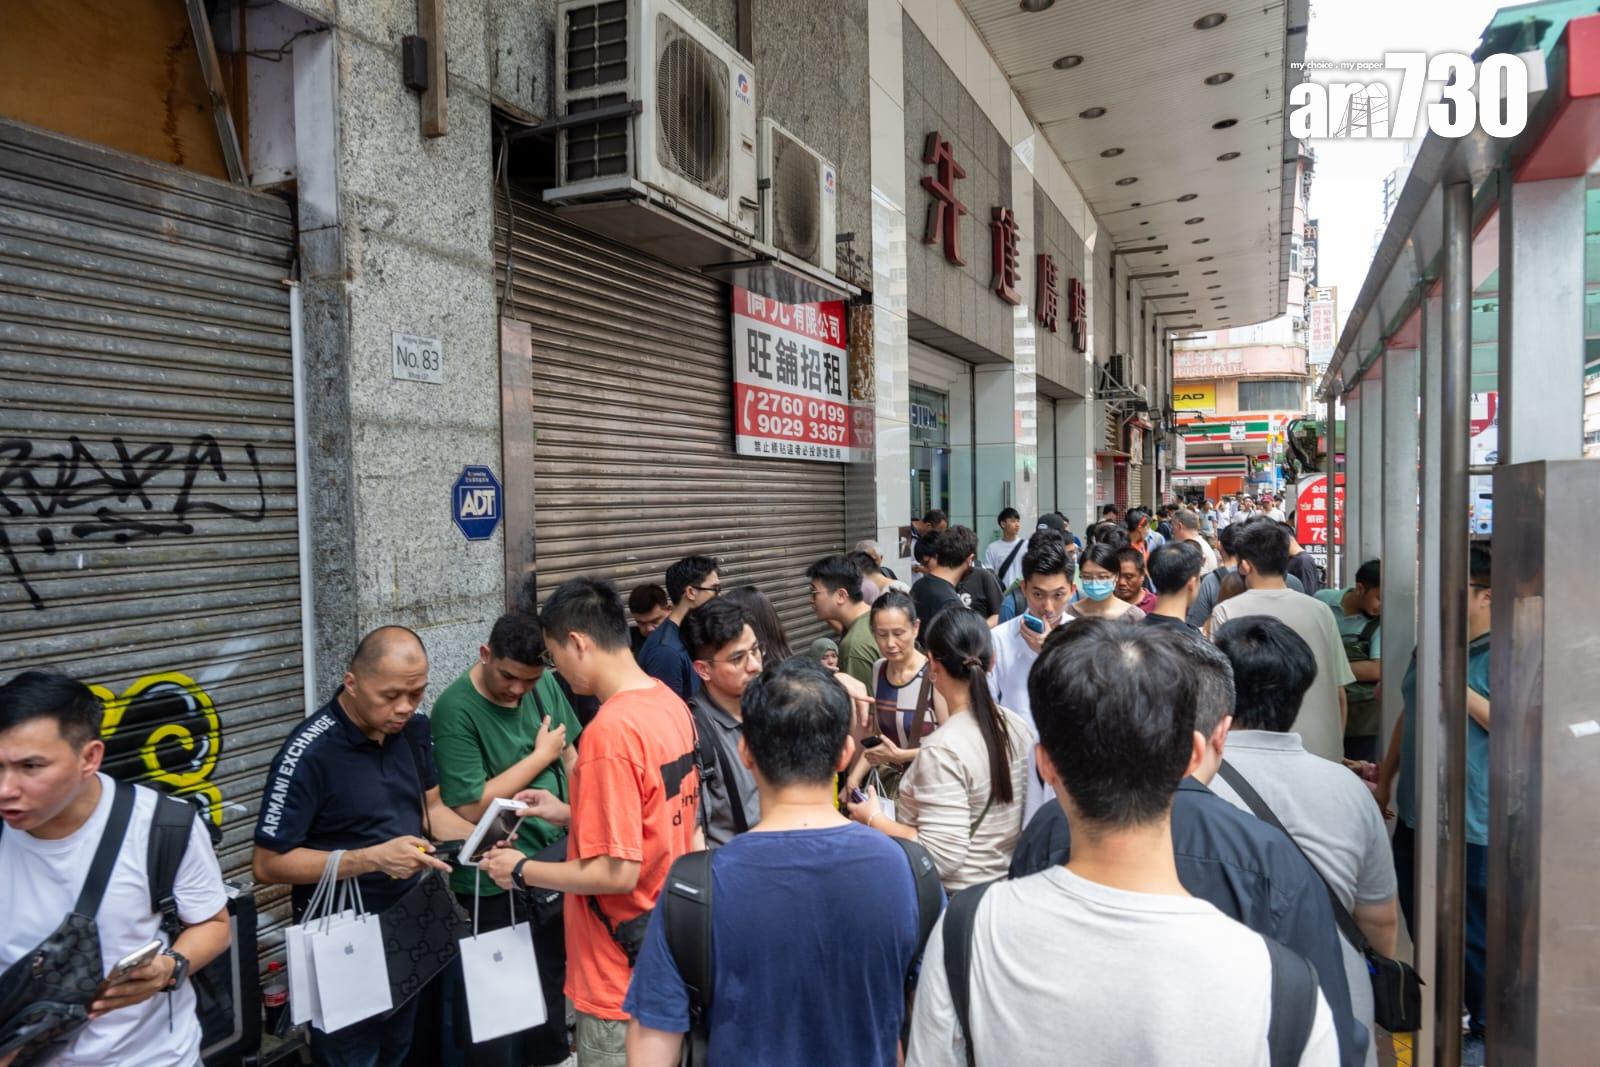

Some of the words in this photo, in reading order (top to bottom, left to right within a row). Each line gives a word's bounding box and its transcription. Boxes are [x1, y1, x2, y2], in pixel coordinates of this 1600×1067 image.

[397, 345, 419, 369] No.
[422, 350, 439, 371] 83
[757, 391, 803, 418] 2760
[809, 403, 845, 423] 0199
[757, 415, 804, 437] 9029
[809, 422, 846, 443] 3367
[461, 489, 496, 517] ADT
[262, 777, 290, 838] ARMANI
[279, 715, 336, 777] EXCHANGE
